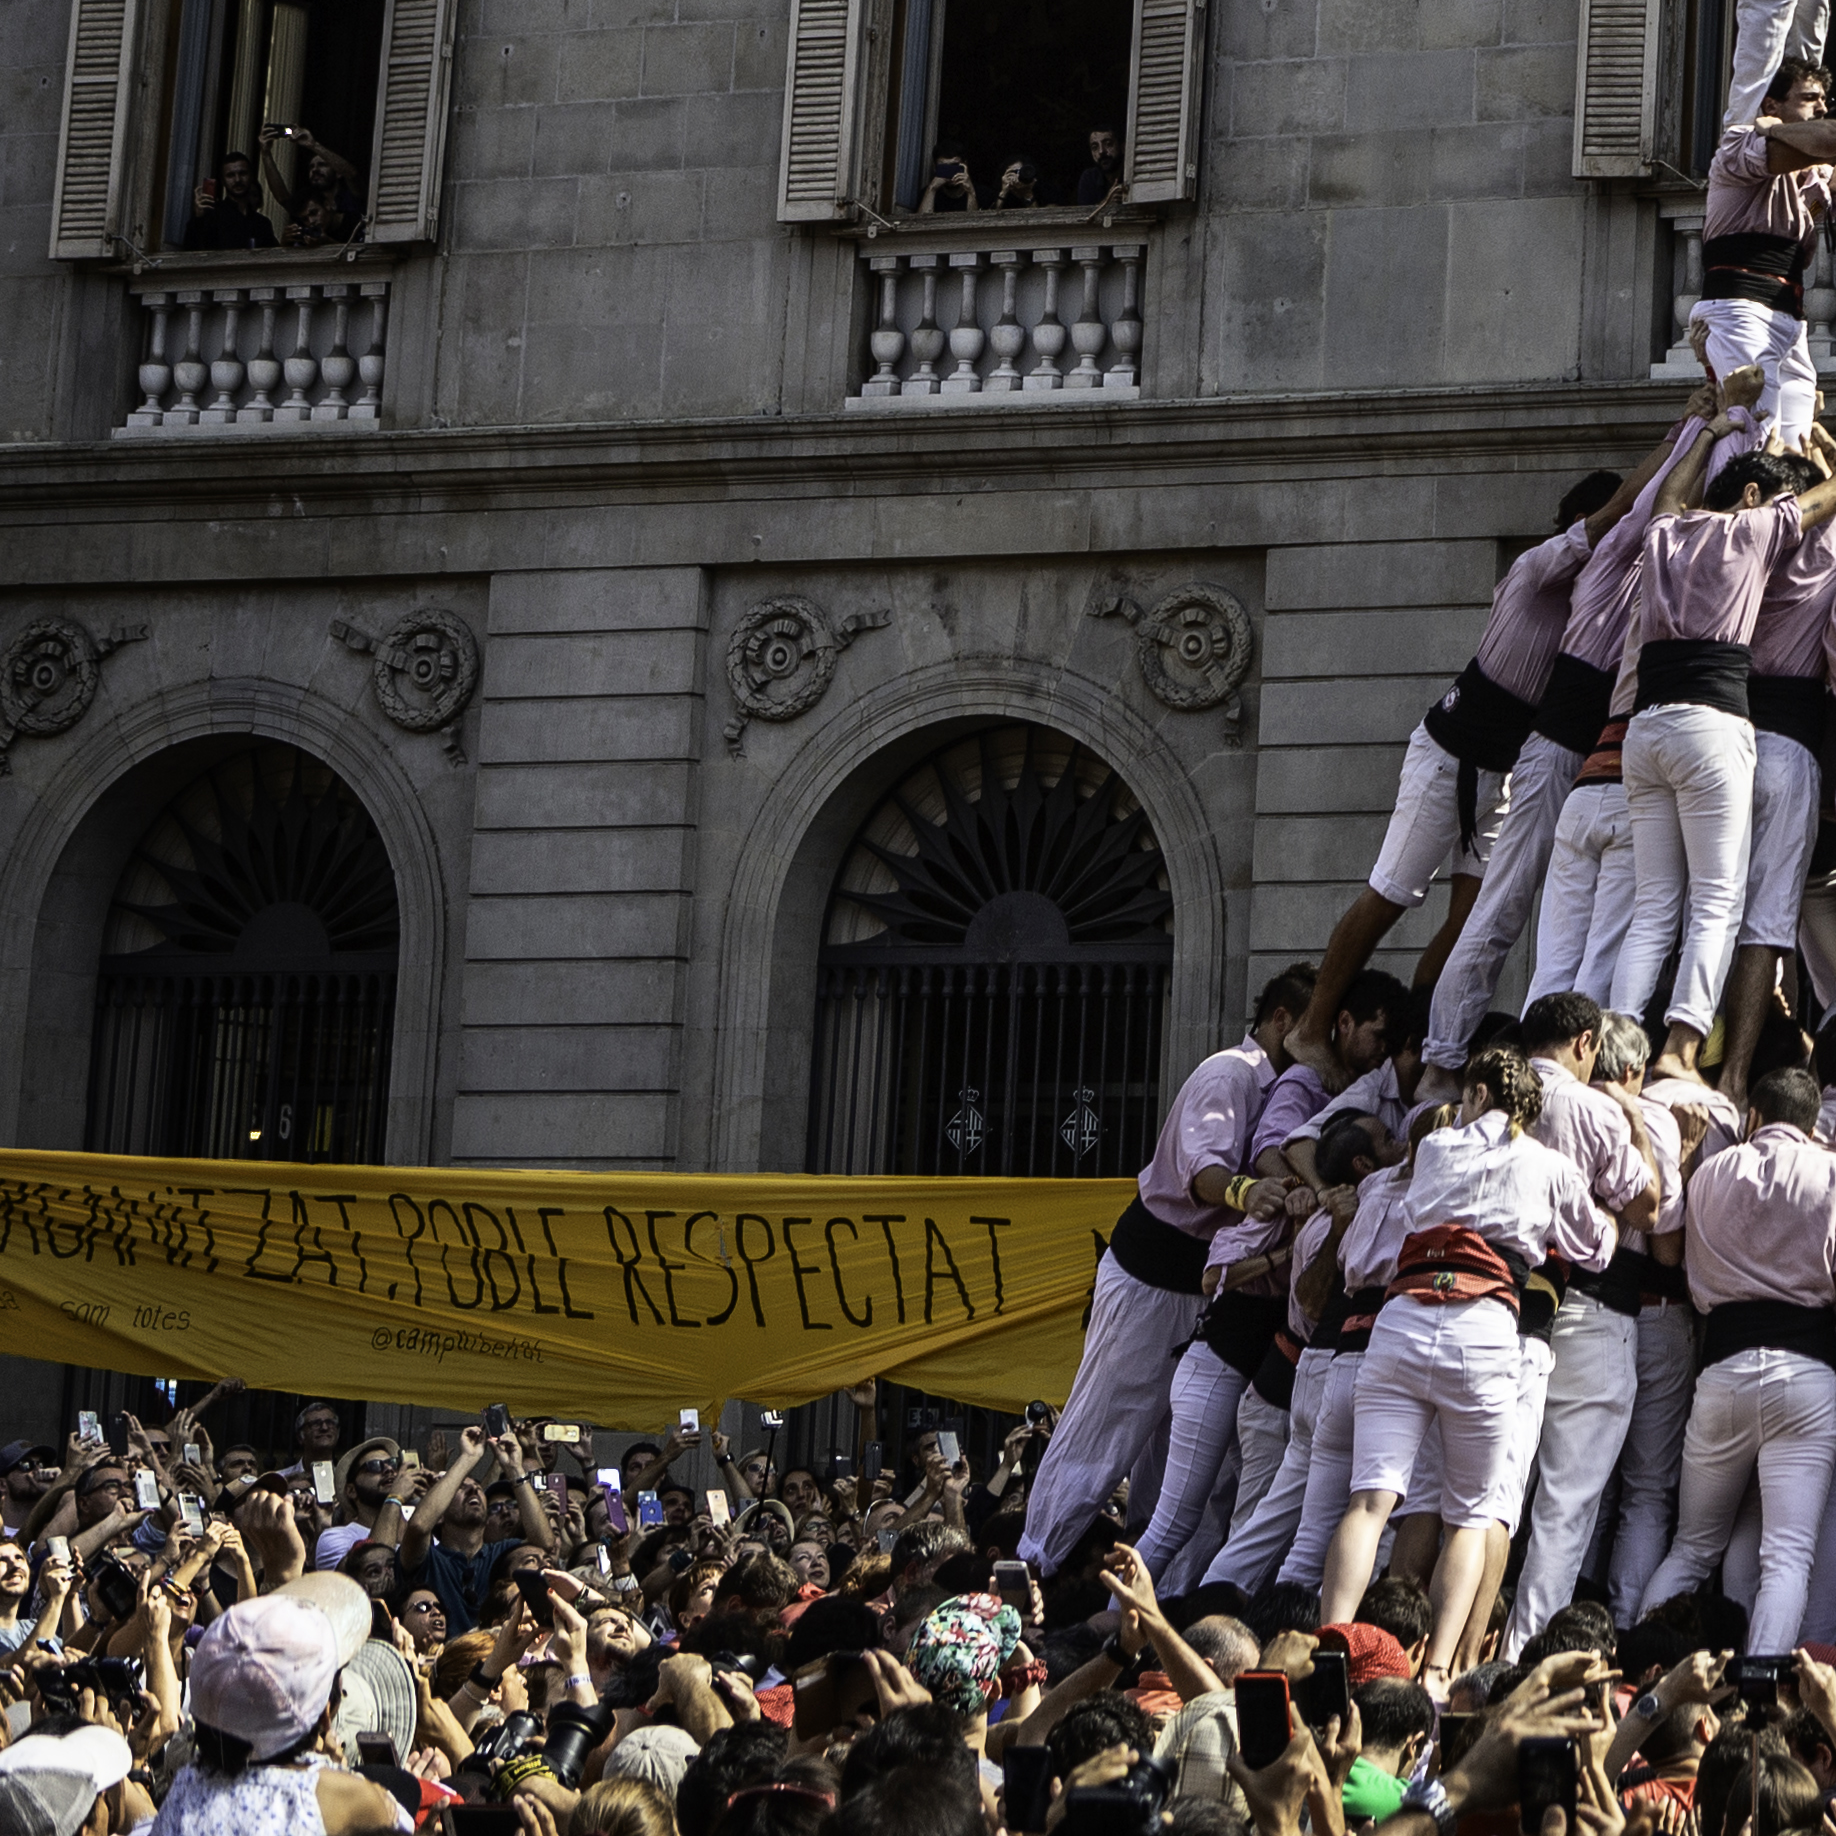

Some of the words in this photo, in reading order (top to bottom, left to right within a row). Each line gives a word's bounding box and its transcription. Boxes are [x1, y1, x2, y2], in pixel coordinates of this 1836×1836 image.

[388, 1192, 595, 1320] POBLE
[602, 1205, 1012, 1330] RESPECTAT
[59, 1301, 111, 1327] som
[132, 1305, 191, 1331] totes
